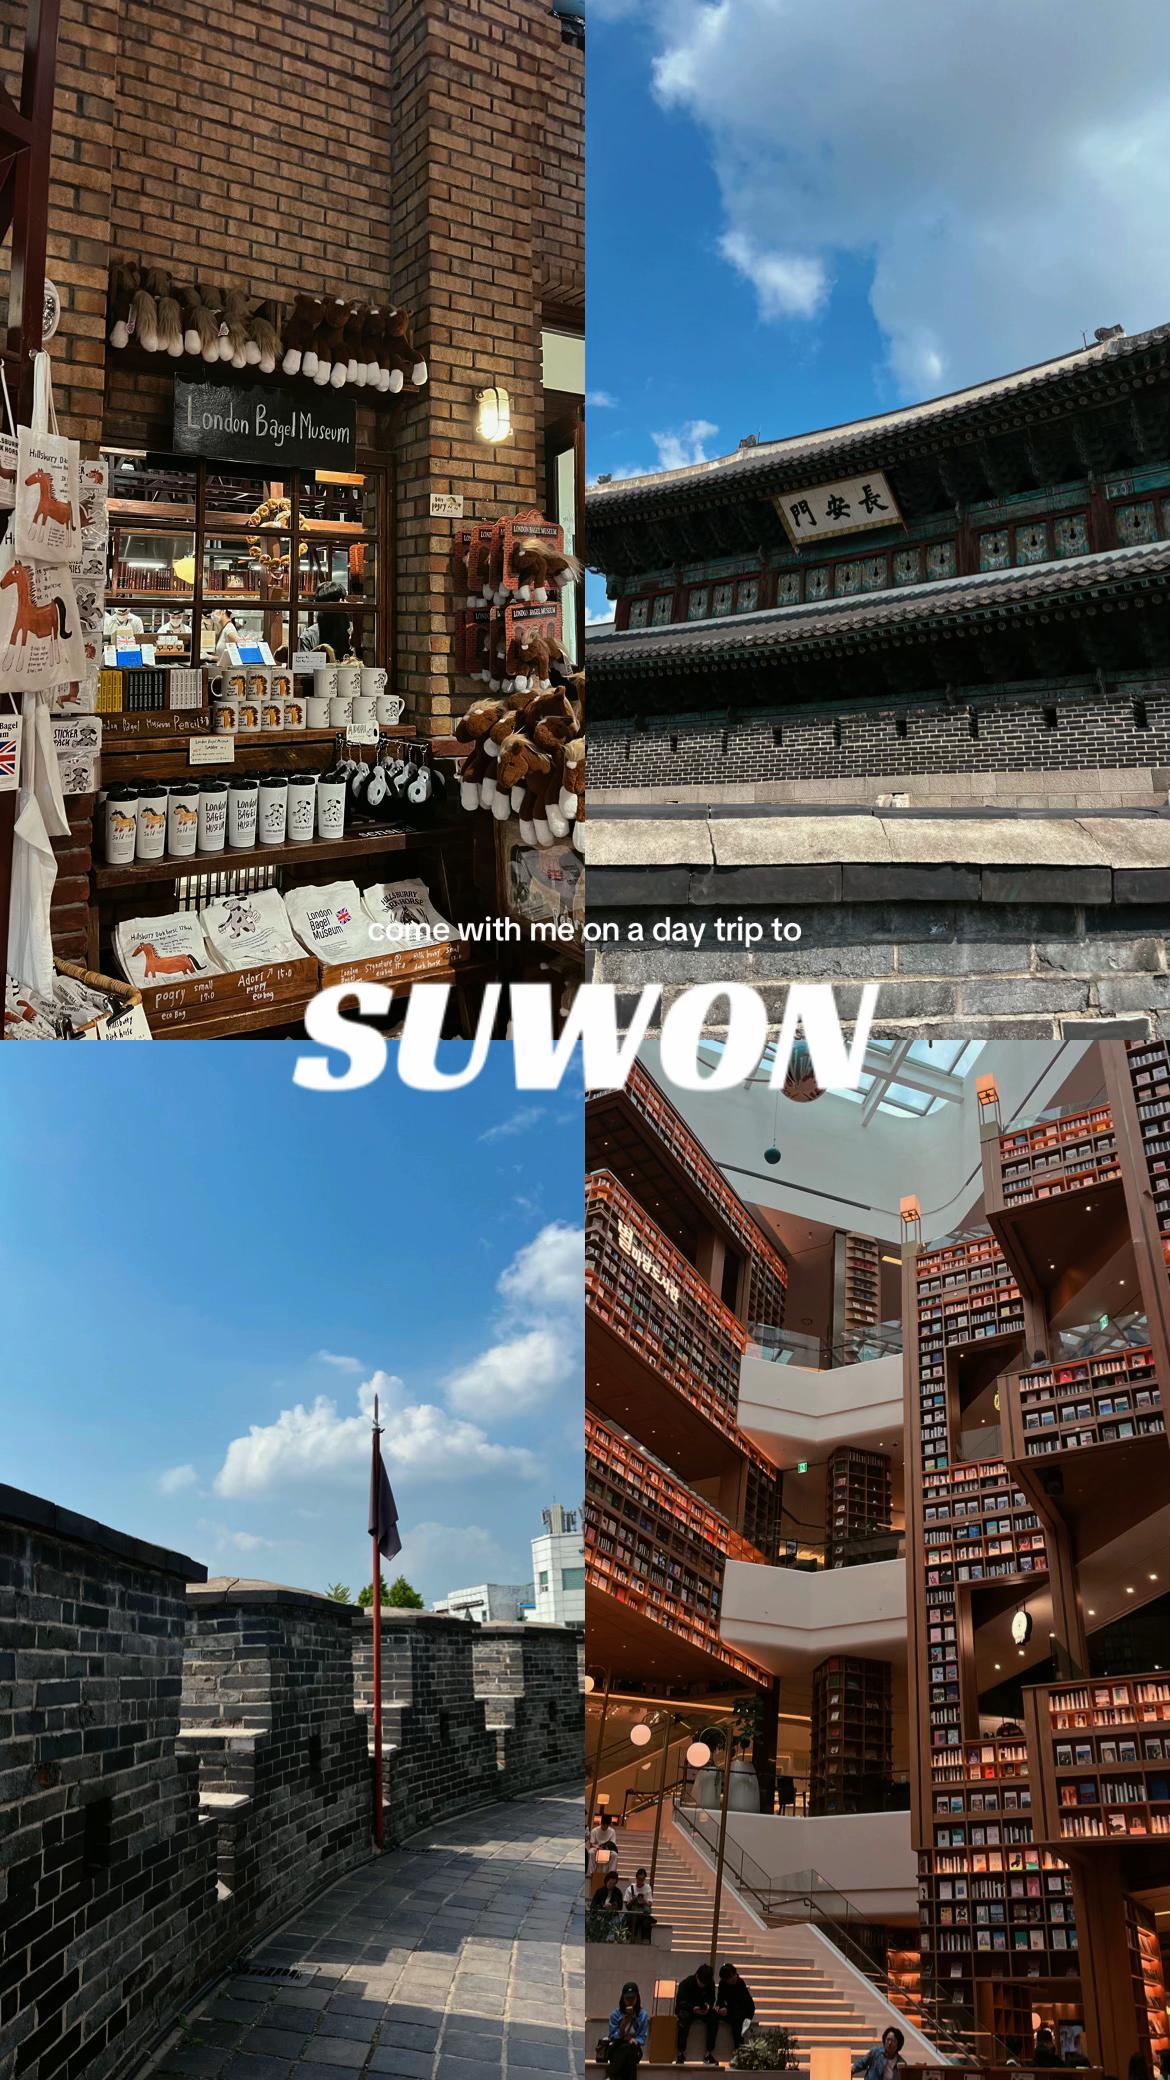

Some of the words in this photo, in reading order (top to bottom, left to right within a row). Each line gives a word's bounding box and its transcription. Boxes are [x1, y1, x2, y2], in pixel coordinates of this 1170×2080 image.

[188, 395, 249, 435] London
[255, 403, 296, 447] Bagel
[299, 410, 350, 444] Museum
[513, 525, 531, 534] LONDON
[540, 606, 556, 615] MUSEUM
[0, 721, 18, 732] Bagel
[146, 718, 171, 730] Museum
[173, 714, 200, 732] Pencil
[53, 728, 79, 739] STICKER
[53, 738, 70, 747] PACK
[305, 908, 333, 921] London
[309, 916, 331, 931] Bagel
[312, 925, 344, 941] Museum
[194, 979, 214, 992] small
[238, 972, 265, 987] Adori
[155, 988, 186, 1009] pogry
[161, 1012, 173, 1021] eco
[174, 1009, 187, 1019] Bag
[617, 1218, 680, 1304] 별마당도서관
